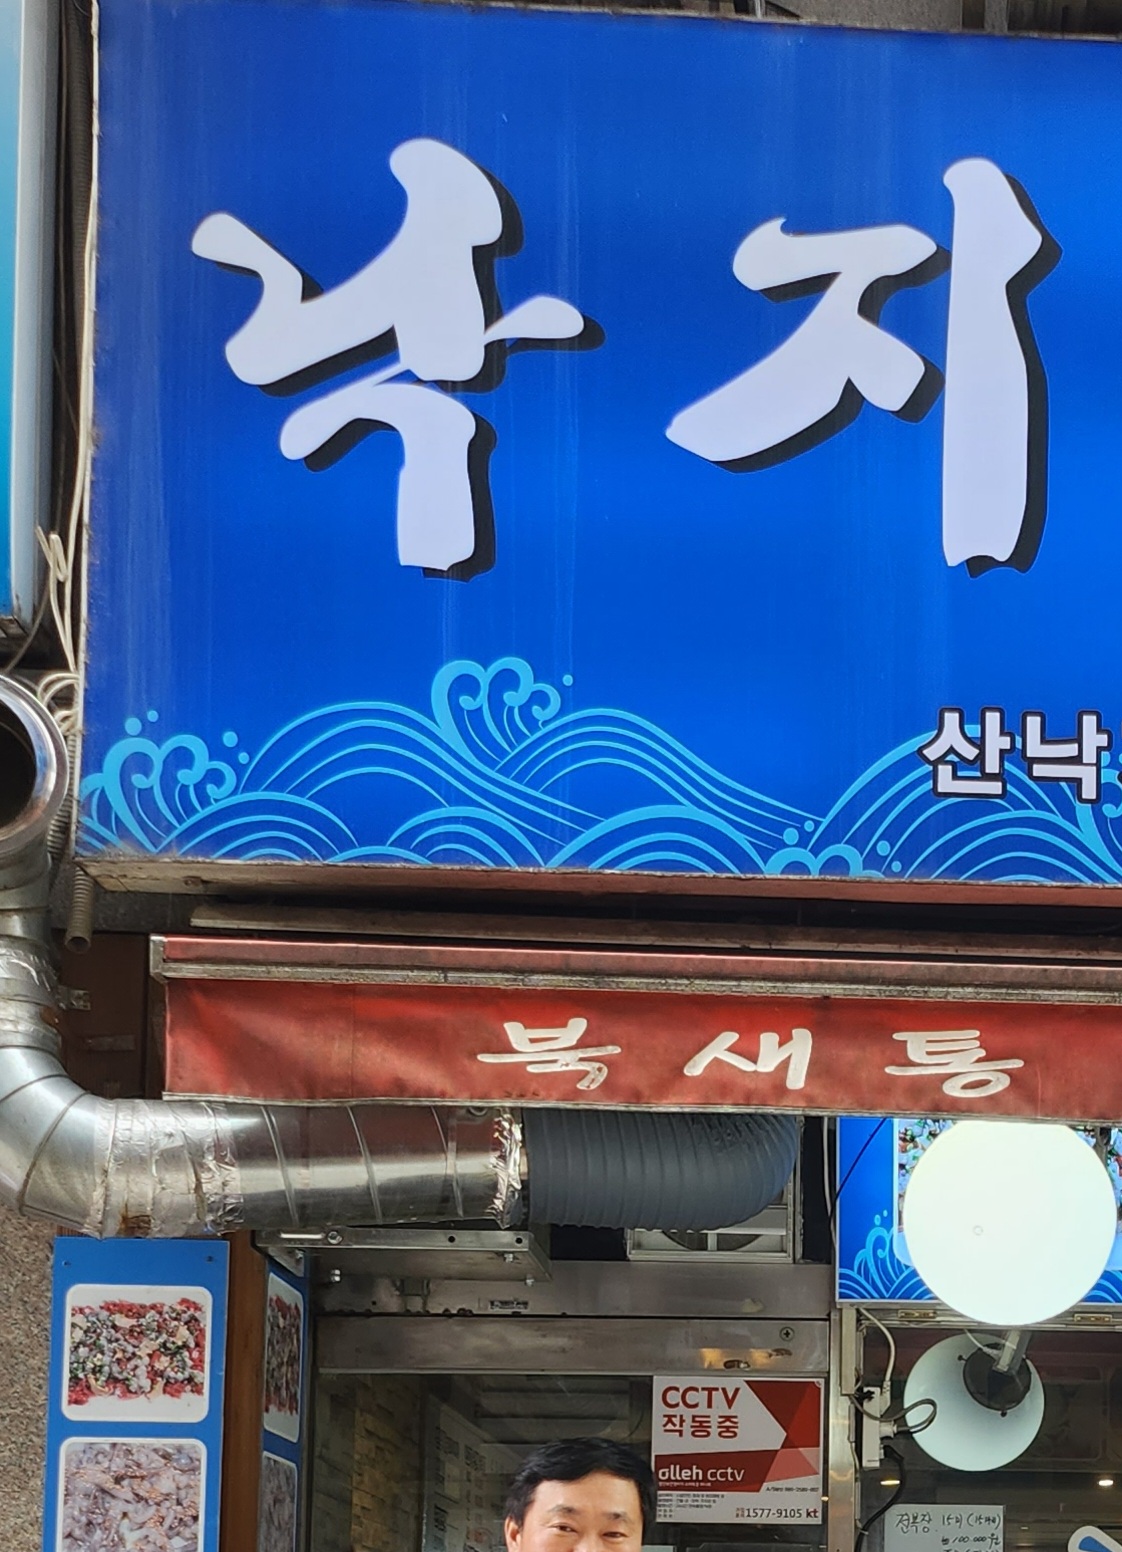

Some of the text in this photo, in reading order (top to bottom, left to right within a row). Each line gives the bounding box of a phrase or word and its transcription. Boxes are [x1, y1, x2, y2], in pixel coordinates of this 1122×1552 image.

[477, 1017, 1024, 1098] 북새통
[661, 1386, 740, 1410] CCTV
[662, 1414, 739, 1439] 작동중
[658, 1464, 745, 1482] olleh cctv
[746, 1508, 803, 1519] 1577-9105
[805, 1507, 819, 1519] kt
